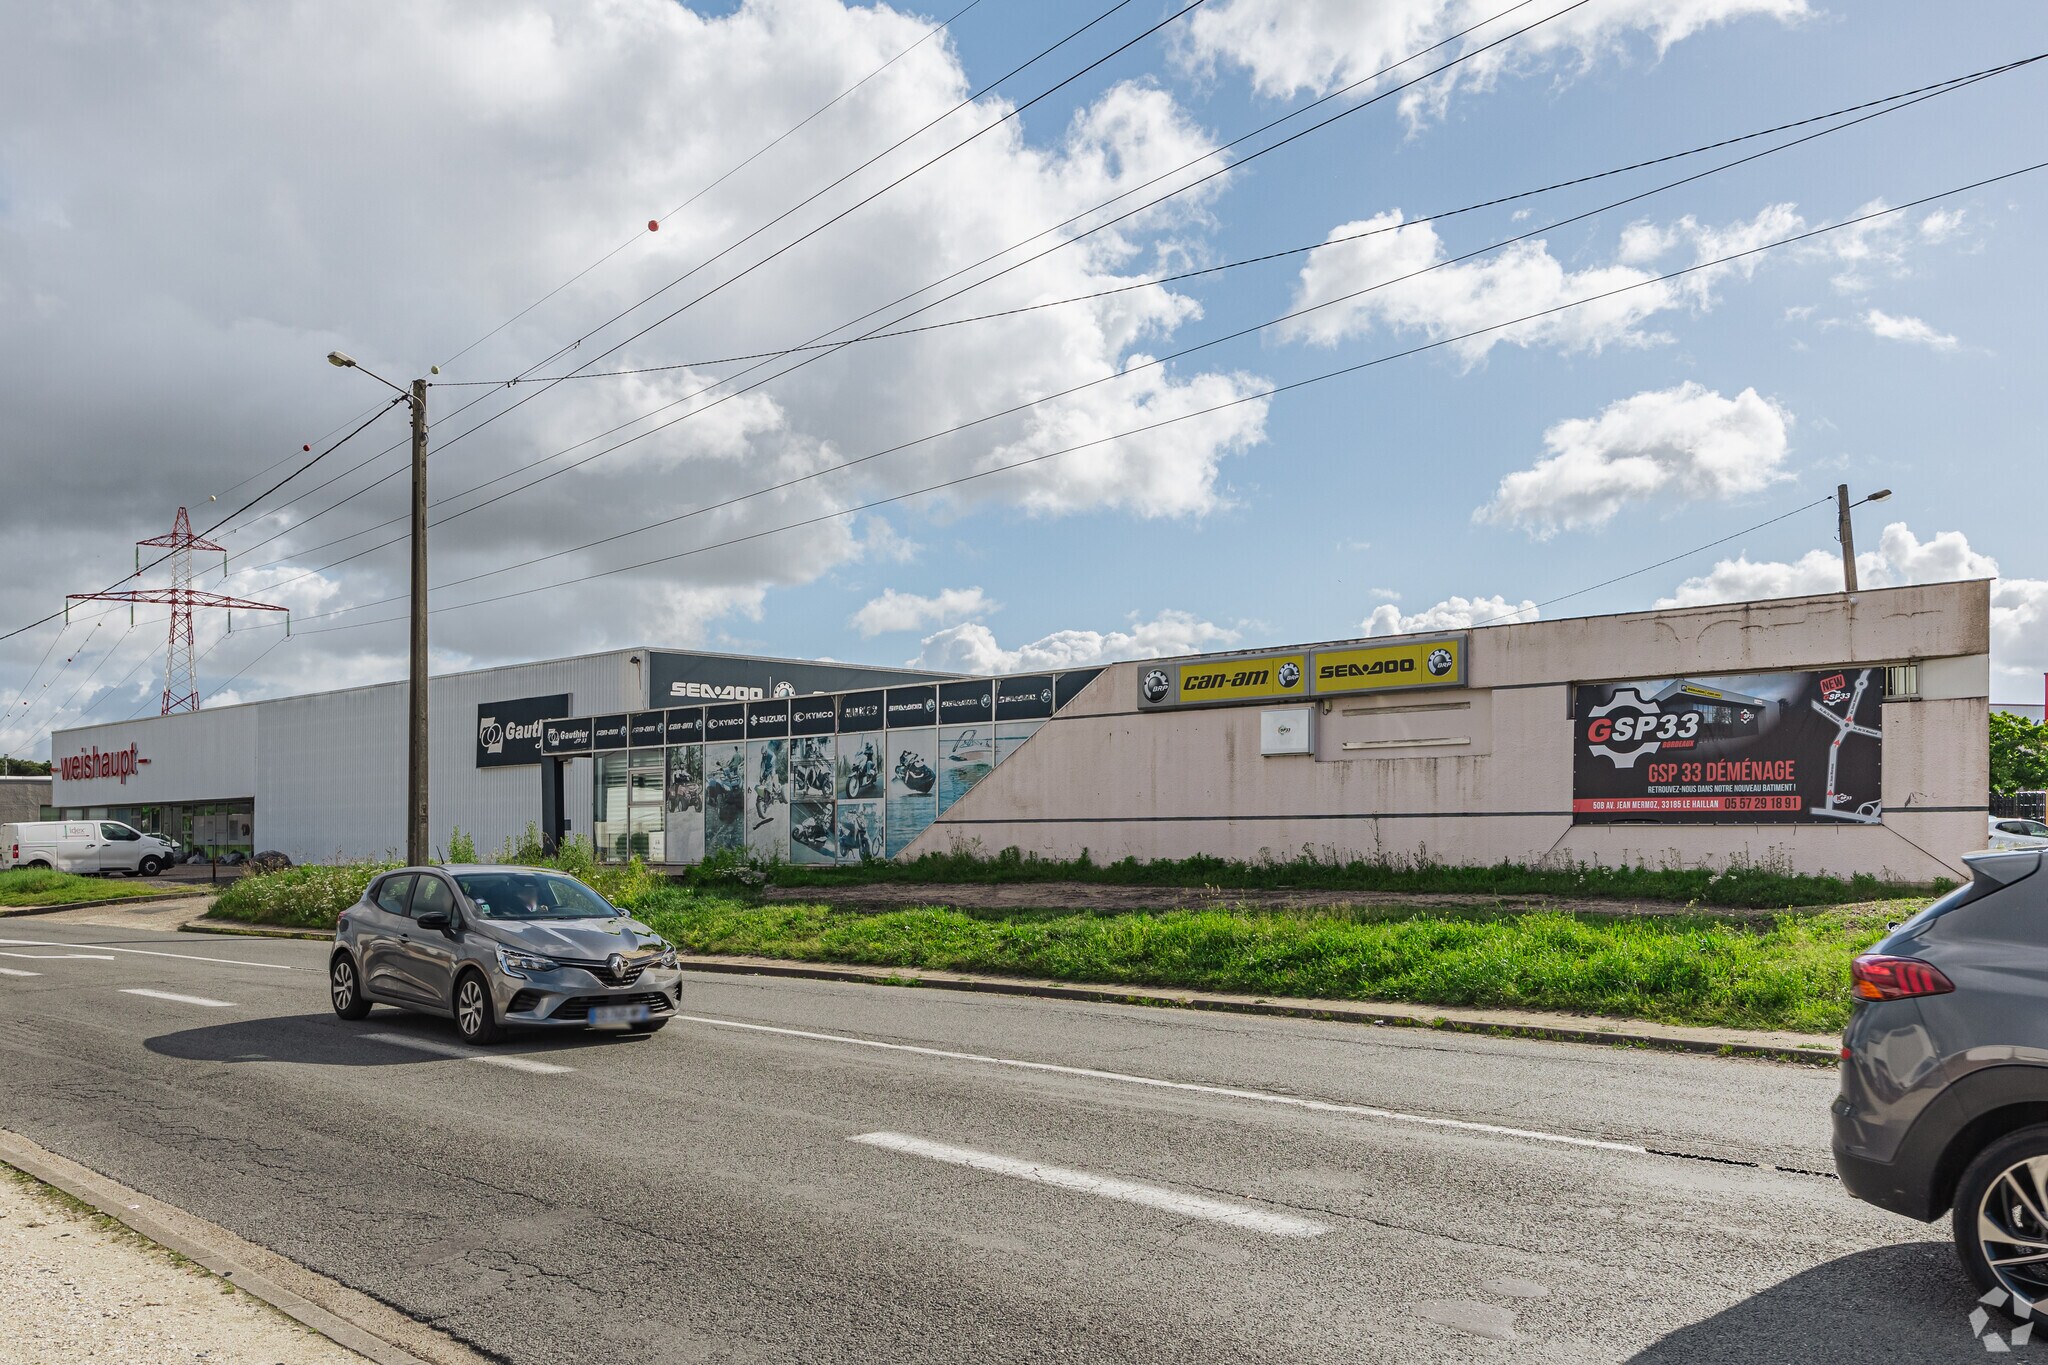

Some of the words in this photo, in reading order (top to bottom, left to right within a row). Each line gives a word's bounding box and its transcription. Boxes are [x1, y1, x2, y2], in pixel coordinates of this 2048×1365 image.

[1183, 669, 1269, 691] can-am
[1822, 675, 1844, 692] NEW
[759, 714, 787, 724] SUZUKI
[805, 711, 834, 720] KYMCO
[718, 718, 744, 727] KYMCO
[1587, 713, 1700, 743] GSP33
[560, 729, 590, 740] Gauthier
[1648, 763, 1678, 783] GSP
[1681, 762, 1702, 782] 33
[1706, 758, 1796, 782] DÉMÉNAGE
[1647, 785, 1697, 794] RETROUVEZ-NOUS
[1697, 785, 1714, 793] DANS
[1713, 784, 1733, 793] NOTRE
[1733, 784, 1762, 793] NOUVEAU
[1762, 783, 1793, 792] BATIMENT
[1616, 801, 1631, 809] JEAN
[1661, 800, 1682, 808] 33185
[1682, 800, 1691, 808] LE
[1691, 800, 1719, 808] HAILLAN
[1724, 798, 1737, 809] 05
[1739, 798, 1752, 809] 57
[1754, 797, 1767, 809] 29
[1771, 797, 1782, 809] 18
[1784, 797, 1797, 809] 91
